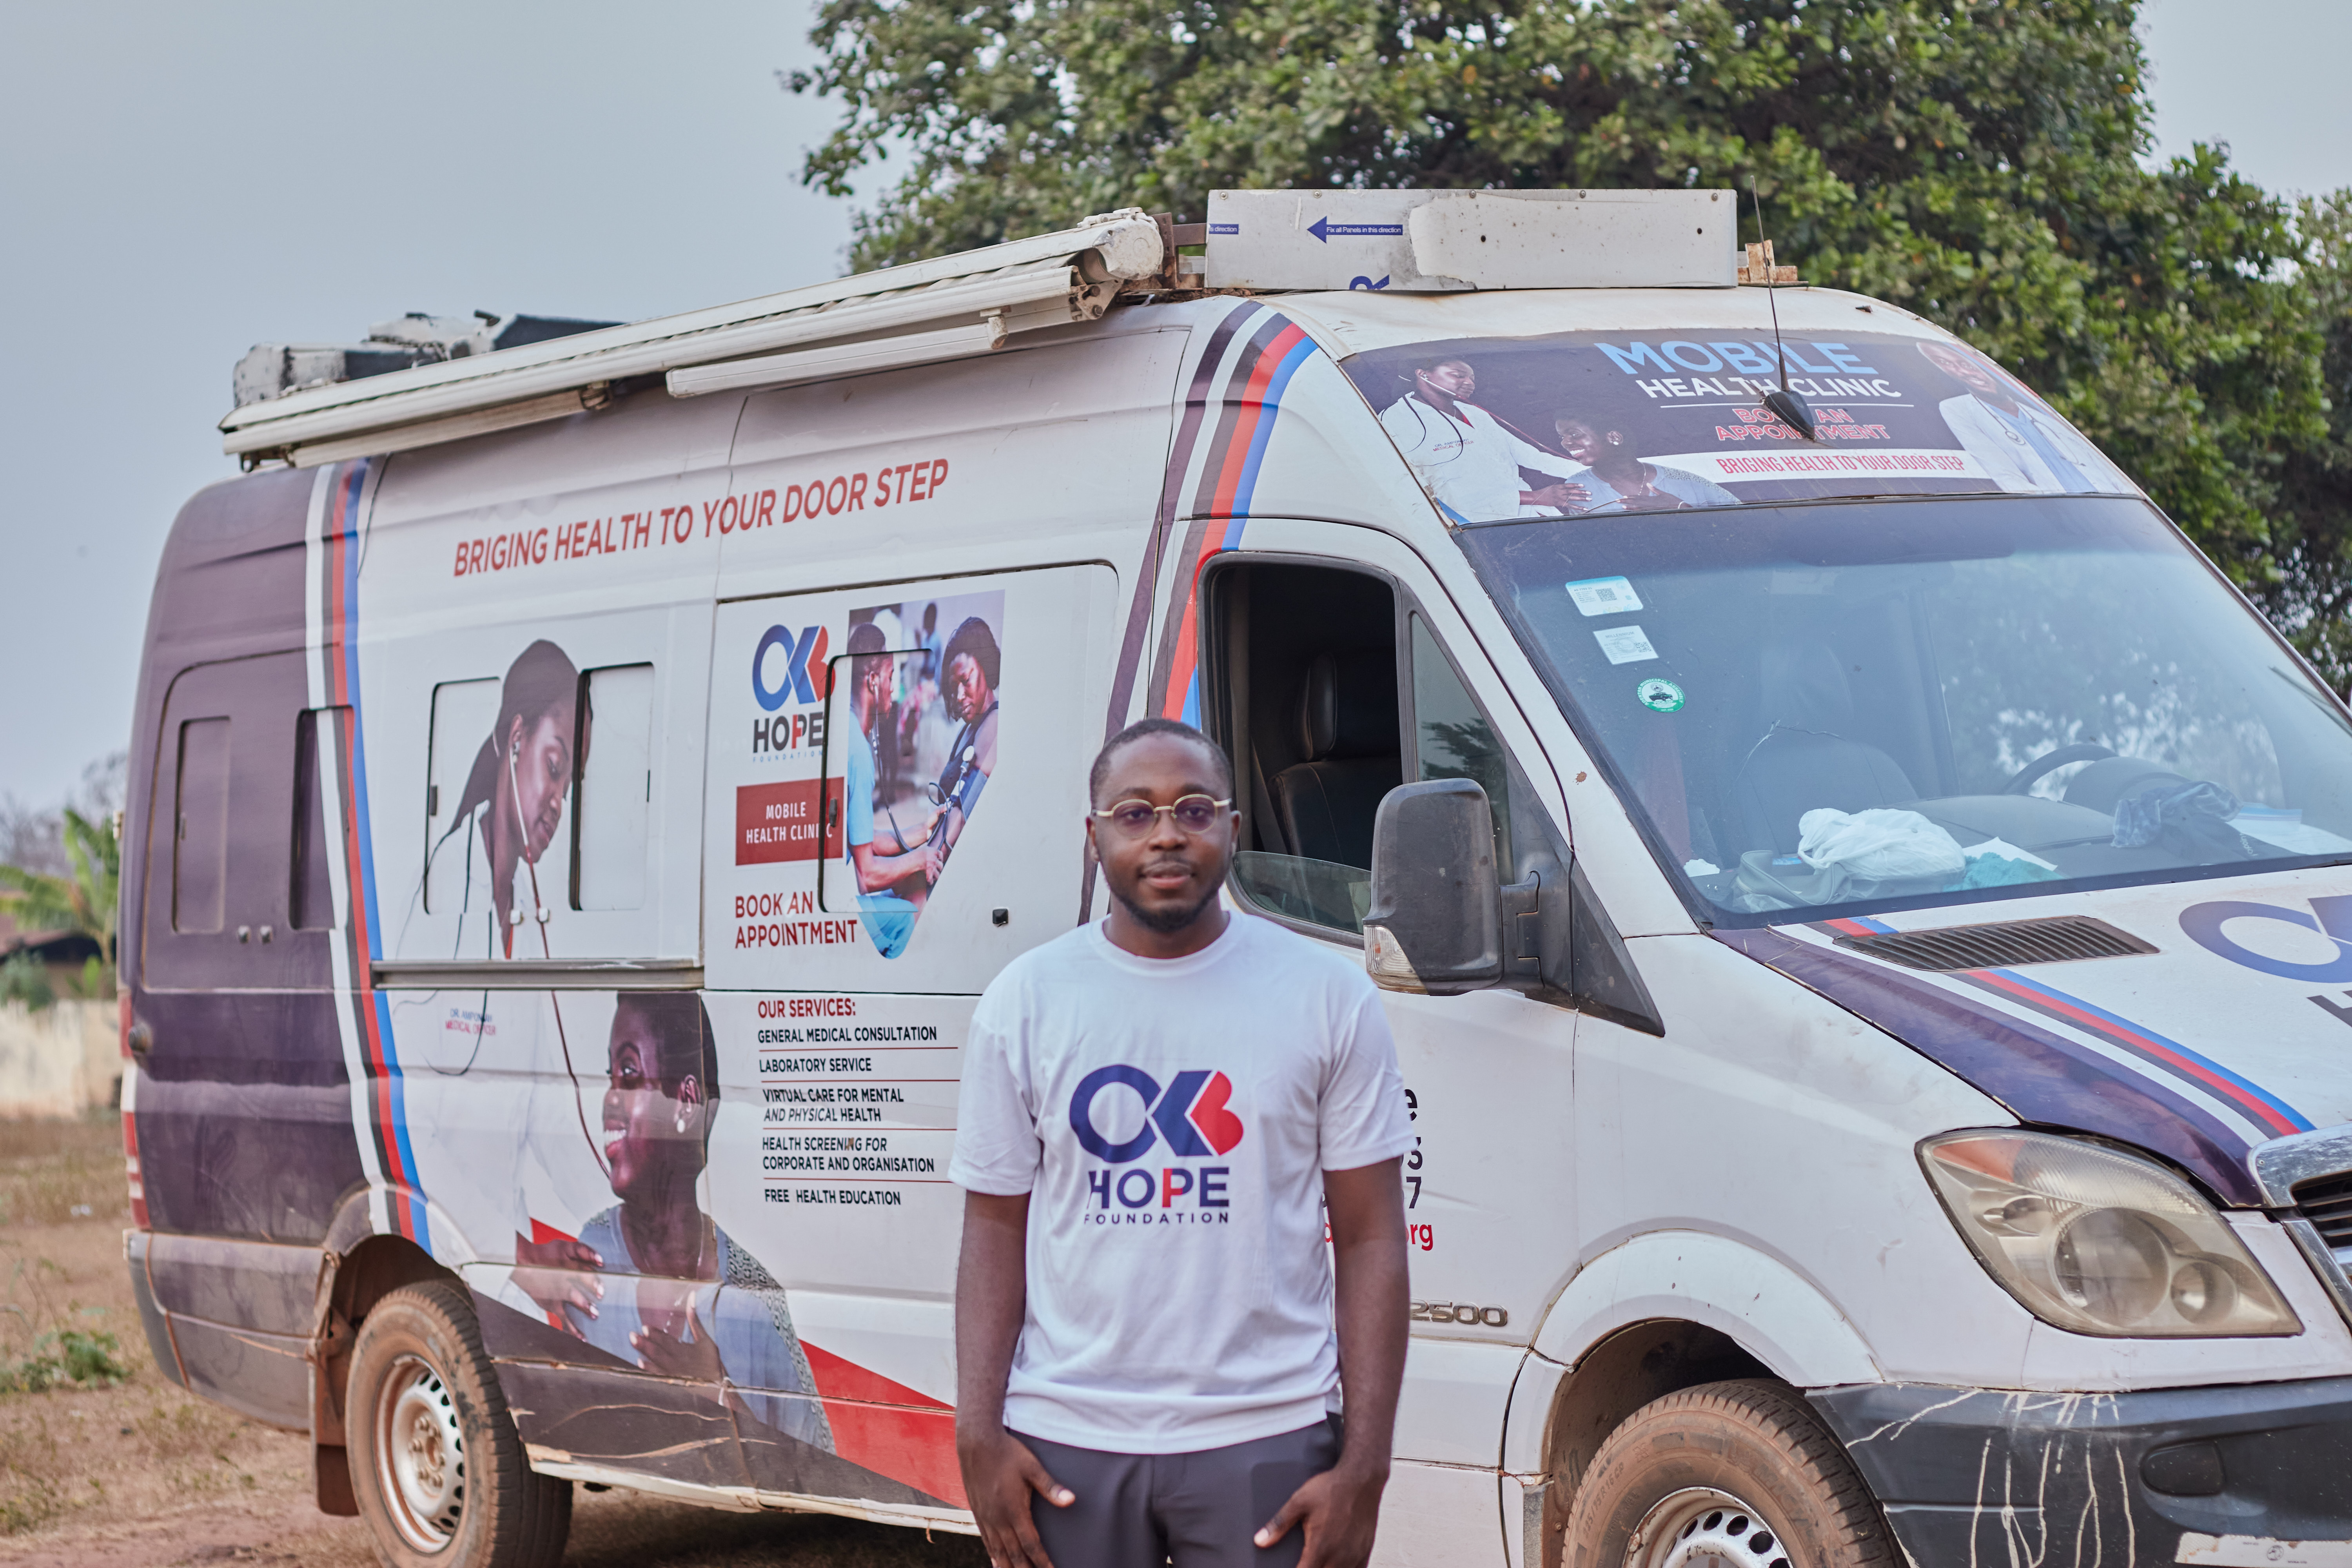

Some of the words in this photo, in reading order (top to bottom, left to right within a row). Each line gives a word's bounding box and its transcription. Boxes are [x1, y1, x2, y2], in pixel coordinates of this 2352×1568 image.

[1594, 341, 1879, 374] MOBILE
[1635, 377, 1781, 397] HEALTH
[1787, 378, 1902, 397] CLINIC
[1815, 408, 1855, 423] AN
[1716, 456, 1786, 474] BRIGING
[1780, 456, 1839, 471] HEALTH
[1832, 455, 1858, 470] TO
[1851, 455, 1898, 470] YOUR
[1891, 455, 1936, 470] DOOR
[1930, 456, 1965, 470] STEP
[453, 527, 548, 577] BRIGING
[554, 510, 652, 561] HEALTH
[660, 504, 693, 545] TO
[703, 489, 776, 537] YOUR
[782, 472, 868, 524] DOOR
[873, 458, 949, 507] STEP
[1641, 678, 1668, 687] MUNICIPAL
[753, 711, 823, 753] HOPE
[753, 750, 823, 763] FOUNDATION
[766, 801, 806, 820] MOBILE
[746, 826, 786, 844] HEALTH
[790, 822, 833, 841] CLINIC
[735, 892, 783, 918] BOOK
[786, 891, 813, 915] AN
[735, 919, 857, 949] APPOINTMENT
[758, 1000, 785, 1018] OUR
[789, 998, 856, 1018] SERVICES:
[758, 1028, 804, 1043] GENERAL
[807, 1027, 852, 1042] MEDICAL
[855, 1026, 937, 1041] CONSULTATION
[759, 1058, 826, 1073] LABORATORY
[829, 1058, 872, 1072] SERVICE
[762, 1088, 807, 1102] VIRTUAL
[808, 1088, 835, 1102] CARE
[837, 1088, 858, 1102] FOR
[861, 1088, 904, 1102] MENTAL
[763, 1108, 785, 1122] AND
[788, 1108, 838, 1122] PHYSICAL
[840, 1108, 881, 1122] HEALTH
[762, 1137, 801, 1151] HEALTH
[804, 1137, 862, 1151] SCREENING
[865, 1137, 887, 1152] FOR
[762, 1156, 824, 1170] CORPORATE
[827, 1156, 849, 1171] AND
[852, 1157, 935, 1172] ORGANISATION
[764, 1189, 790, 1203] FREE
[796, 1189, 836, 1203] HEALTH
[839, 1190, 901, 1205] EDUCATION
[1086, 1166, 1229, 1209] HOPE
[1083, 1212, 1229, 1225] FOUNDATION
[1410, 1298, 1508, 1327] 2500
